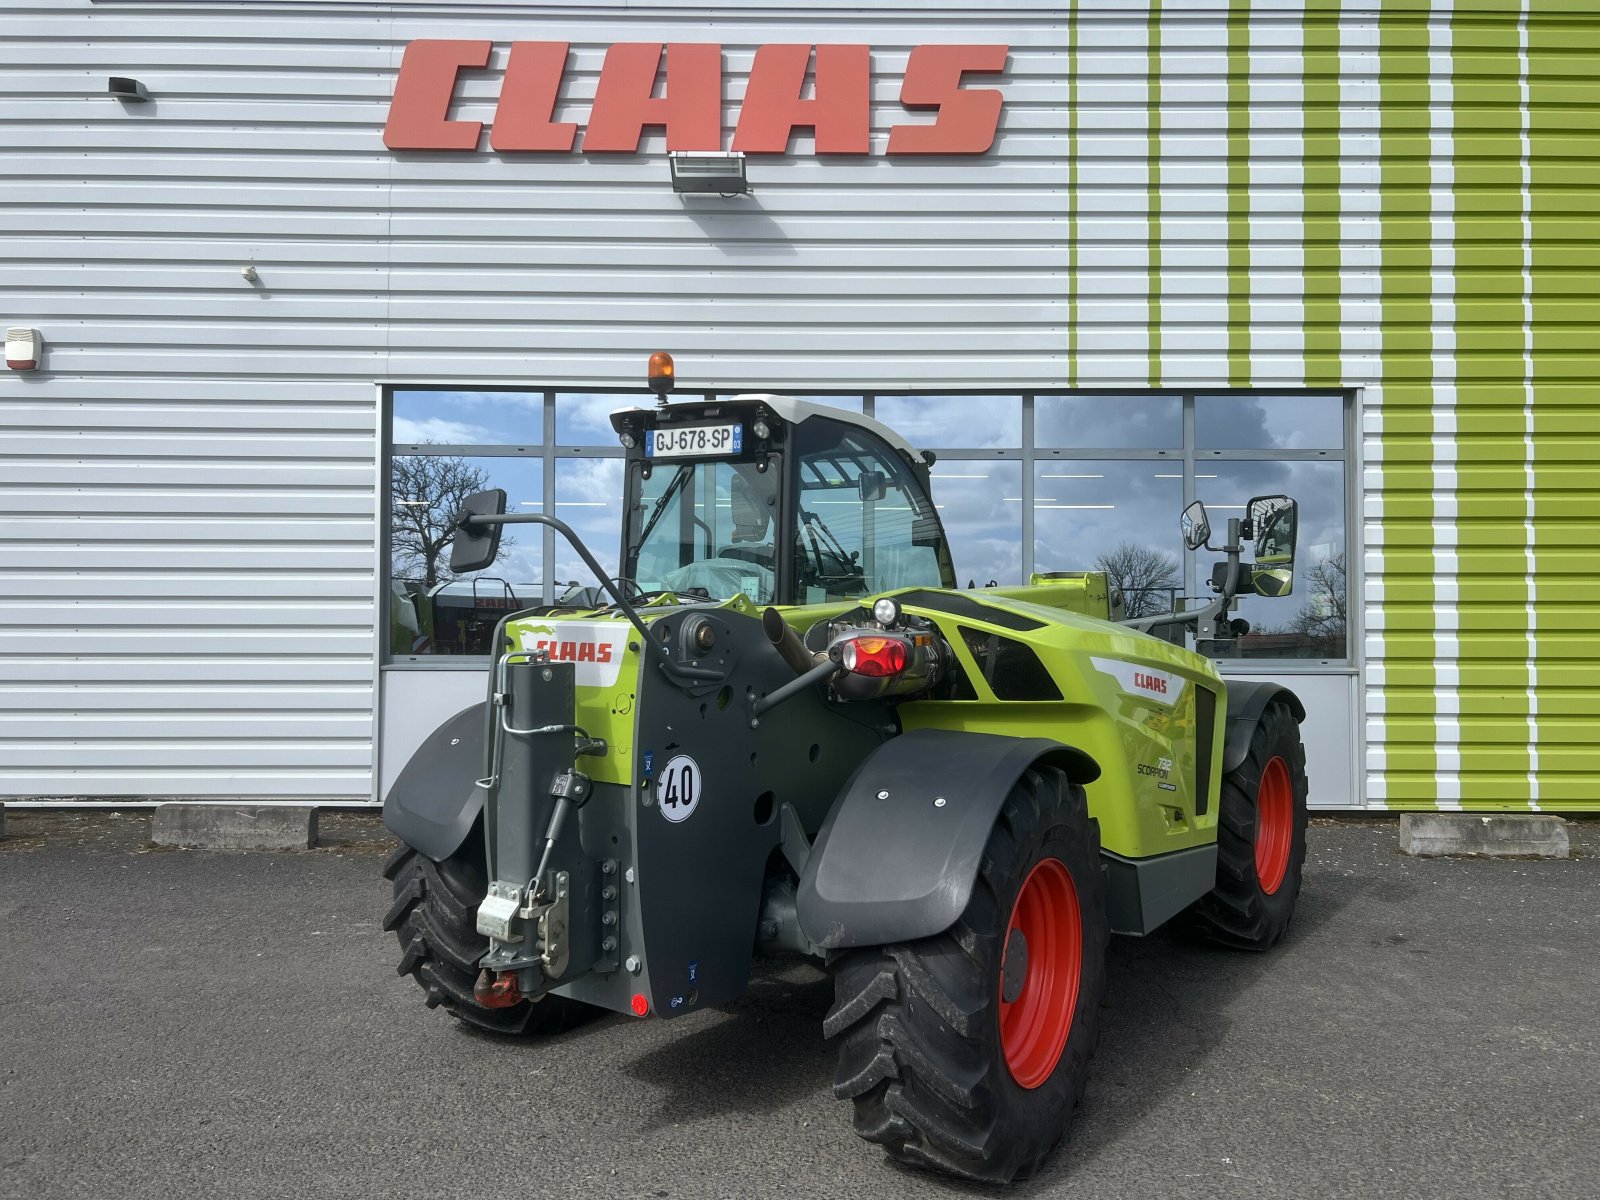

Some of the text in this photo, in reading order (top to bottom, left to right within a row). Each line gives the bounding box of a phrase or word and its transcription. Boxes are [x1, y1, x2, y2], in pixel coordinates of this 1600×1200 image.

[383, 40, 1010, 156] CLAAS
[656, 428, 731, 451] GJ-678-SP
[1134, 672, 1167, 694] CLAAS
[1137, 763, 1169, 779] SCORPION
[1158, 757, 1172, 771] 732
[664, 765, 693, 809] 40
